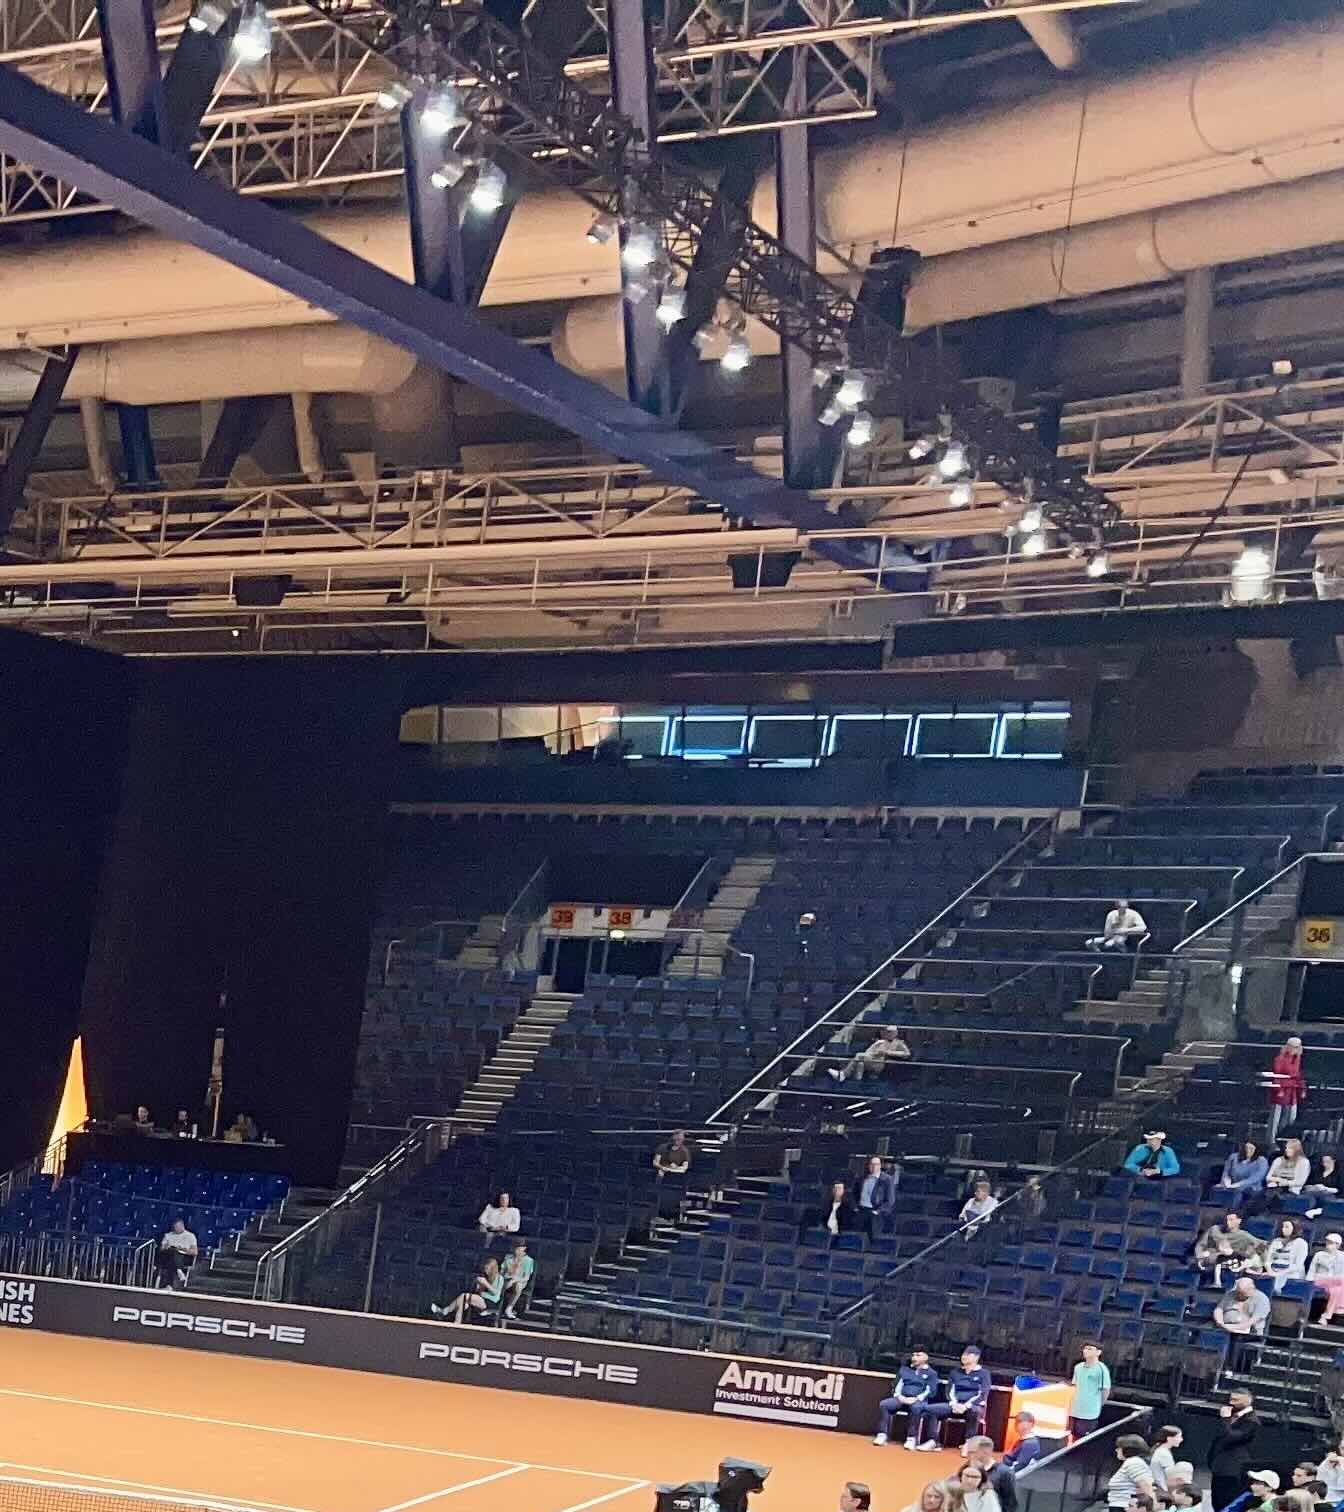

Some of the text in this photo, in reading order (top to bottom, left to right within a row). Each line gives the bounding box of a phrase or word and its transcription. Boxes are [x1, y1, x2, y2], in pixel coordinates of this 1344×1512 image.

[113, 1306, 306, 1344] PORSCHE
[419, 1342, 639, 1385] PORSCHE
[718, 1361, 844, 1400] Amundi
[716, 1388, 840, 1413] Investment Solutions
